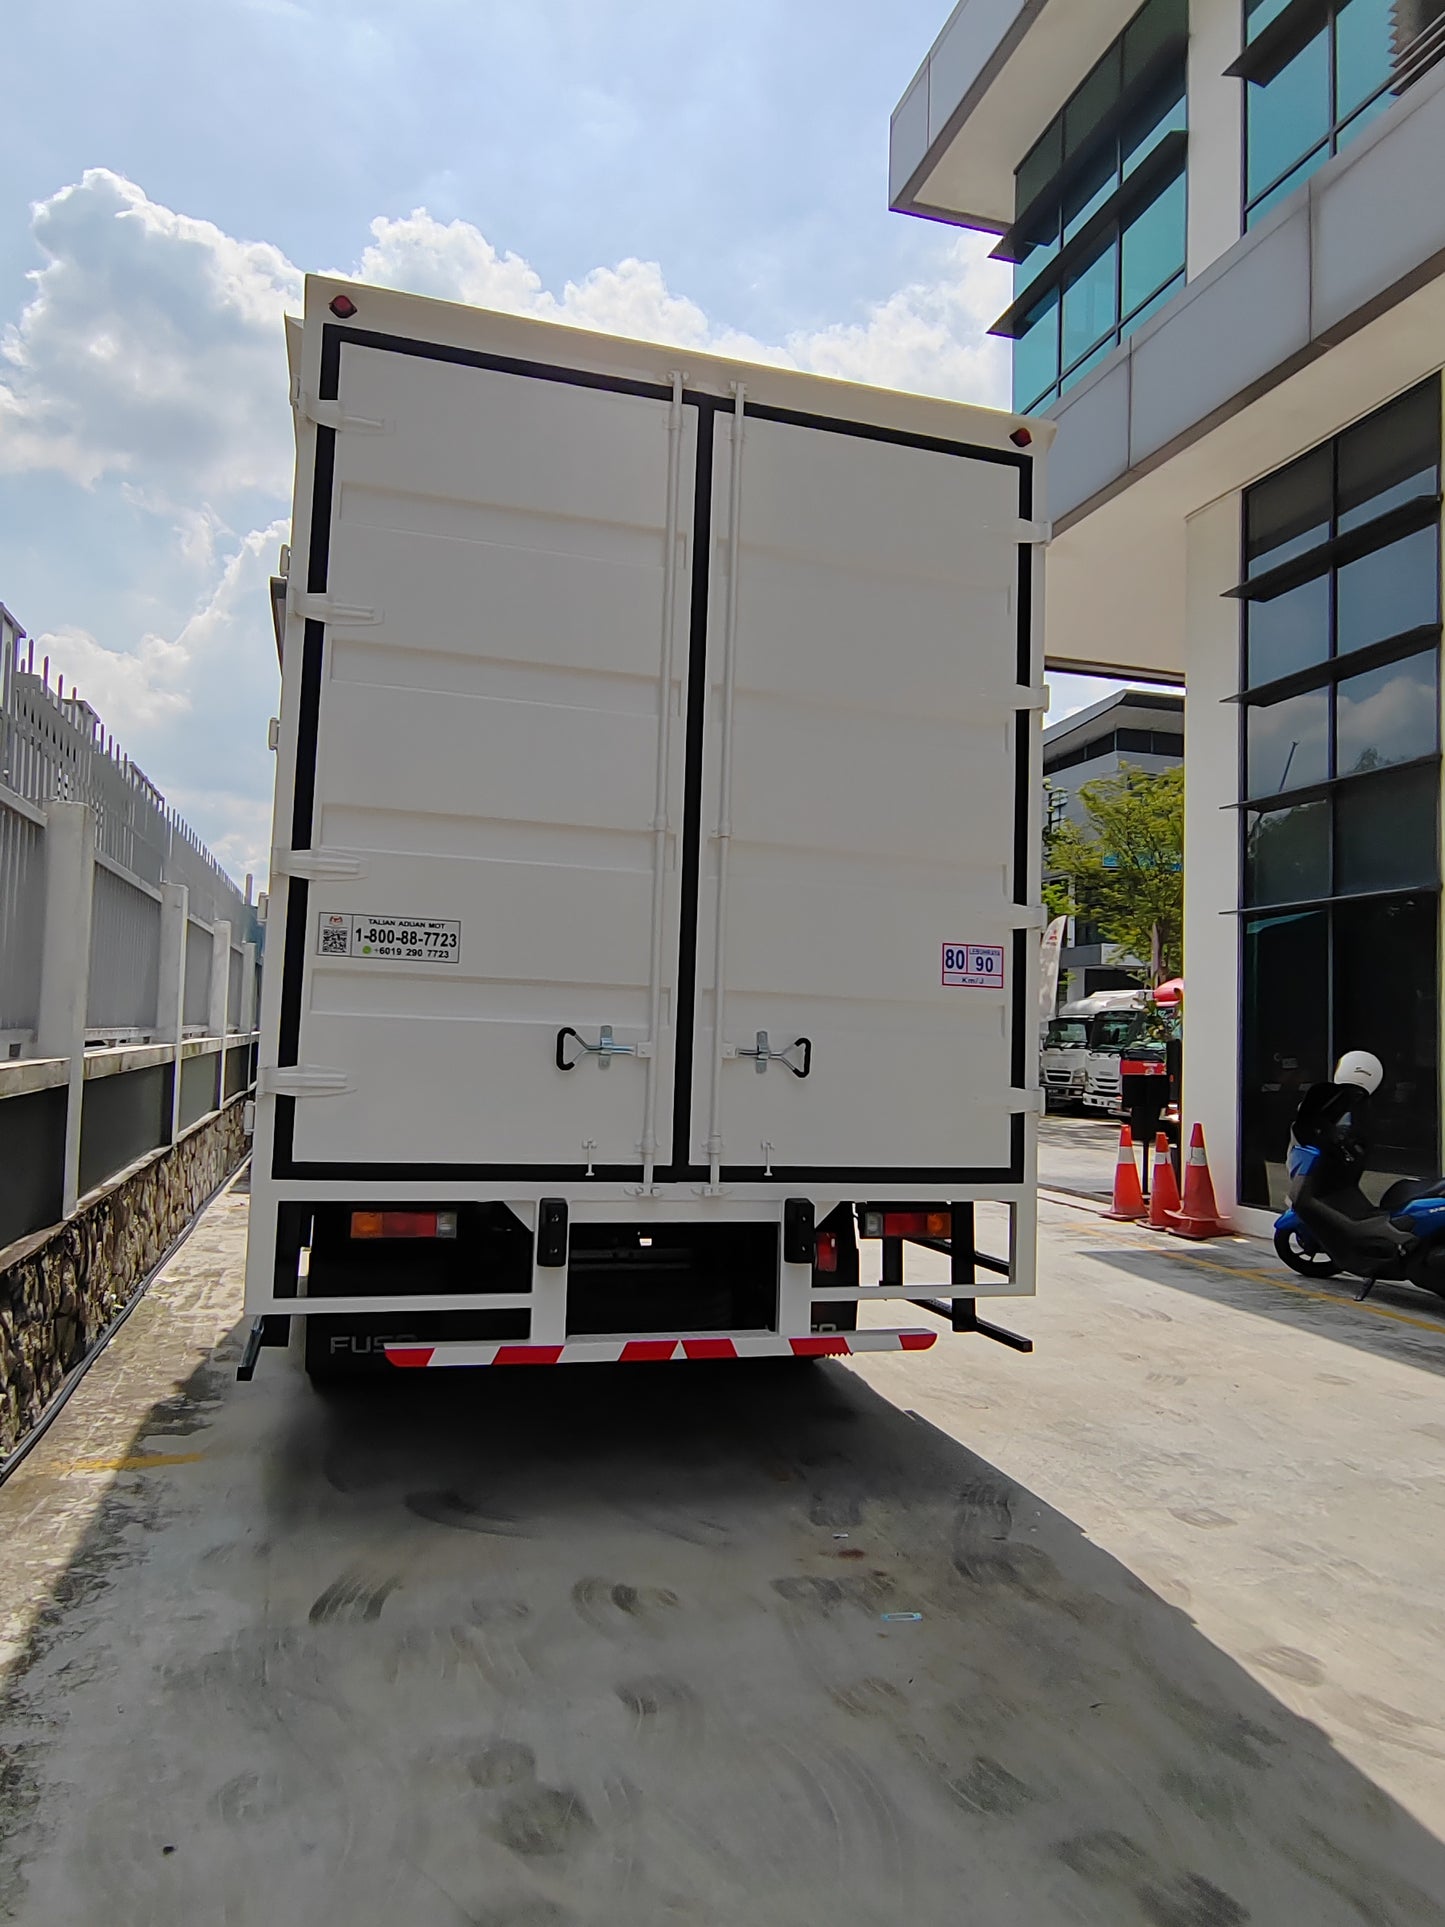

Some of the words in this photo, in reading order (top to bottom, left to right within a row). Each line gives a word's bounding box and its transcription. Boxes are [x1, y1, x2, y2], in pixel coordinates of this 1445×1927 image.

[368, 918, 395, 926] TALIAN
[398, 920, 425, 928] ADUAN
[428, 922, 445, 930] MOT
[356, 928, 457, 948] 1-800-88-7723
[374, 947, 402, 956] +6019
[406, 948, 423, 957] 290
[427, 950, 449, 959] 7723
[945, 949, 965, 970] 80
[976, 956, 993, 973] 90
